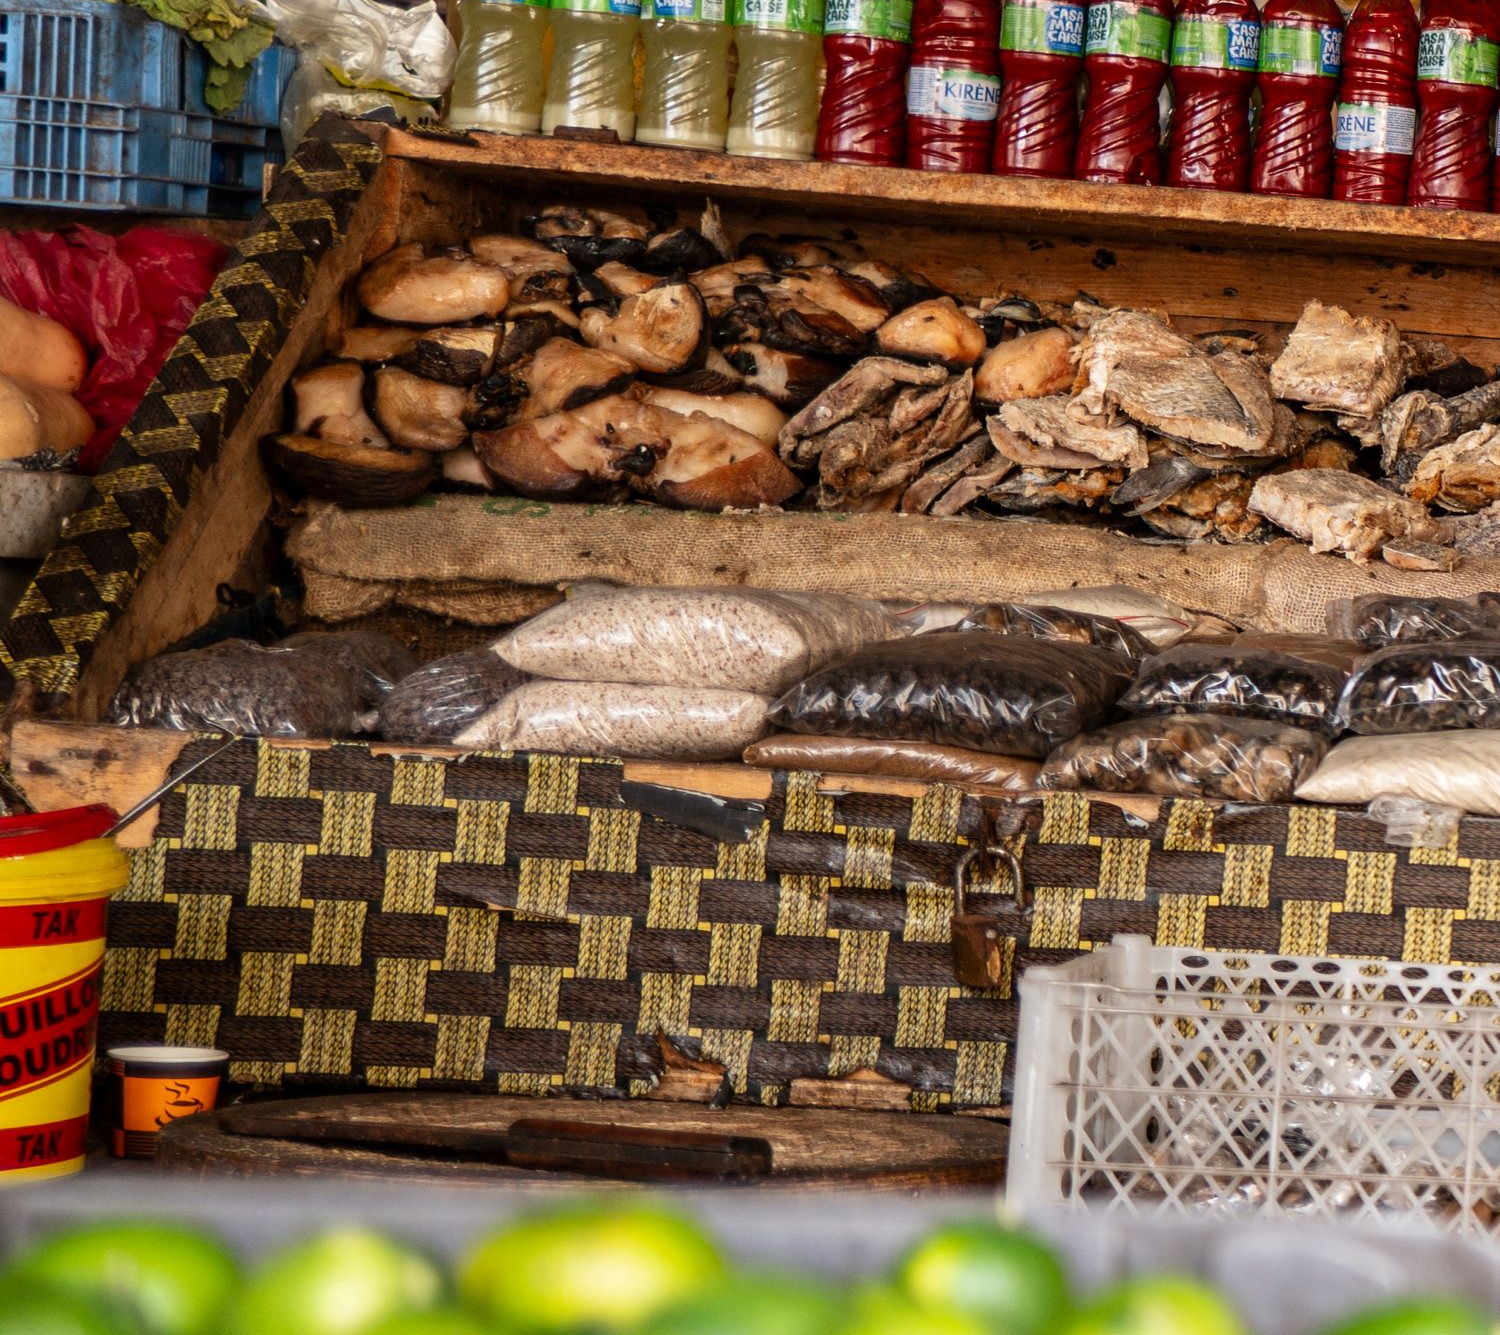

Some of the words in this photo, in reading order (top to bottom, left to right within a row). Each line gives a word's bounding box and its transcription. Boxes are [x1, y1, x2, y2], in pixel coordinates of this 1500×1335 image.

[1050, 8, 1084, 22] CASA
[1050, 19, 1083, 34] MAN
[1419, 43, 1444, 56] MAN
[31, 908, 81, 940] TAK
[17, 1129, 62, 1163] TAK
